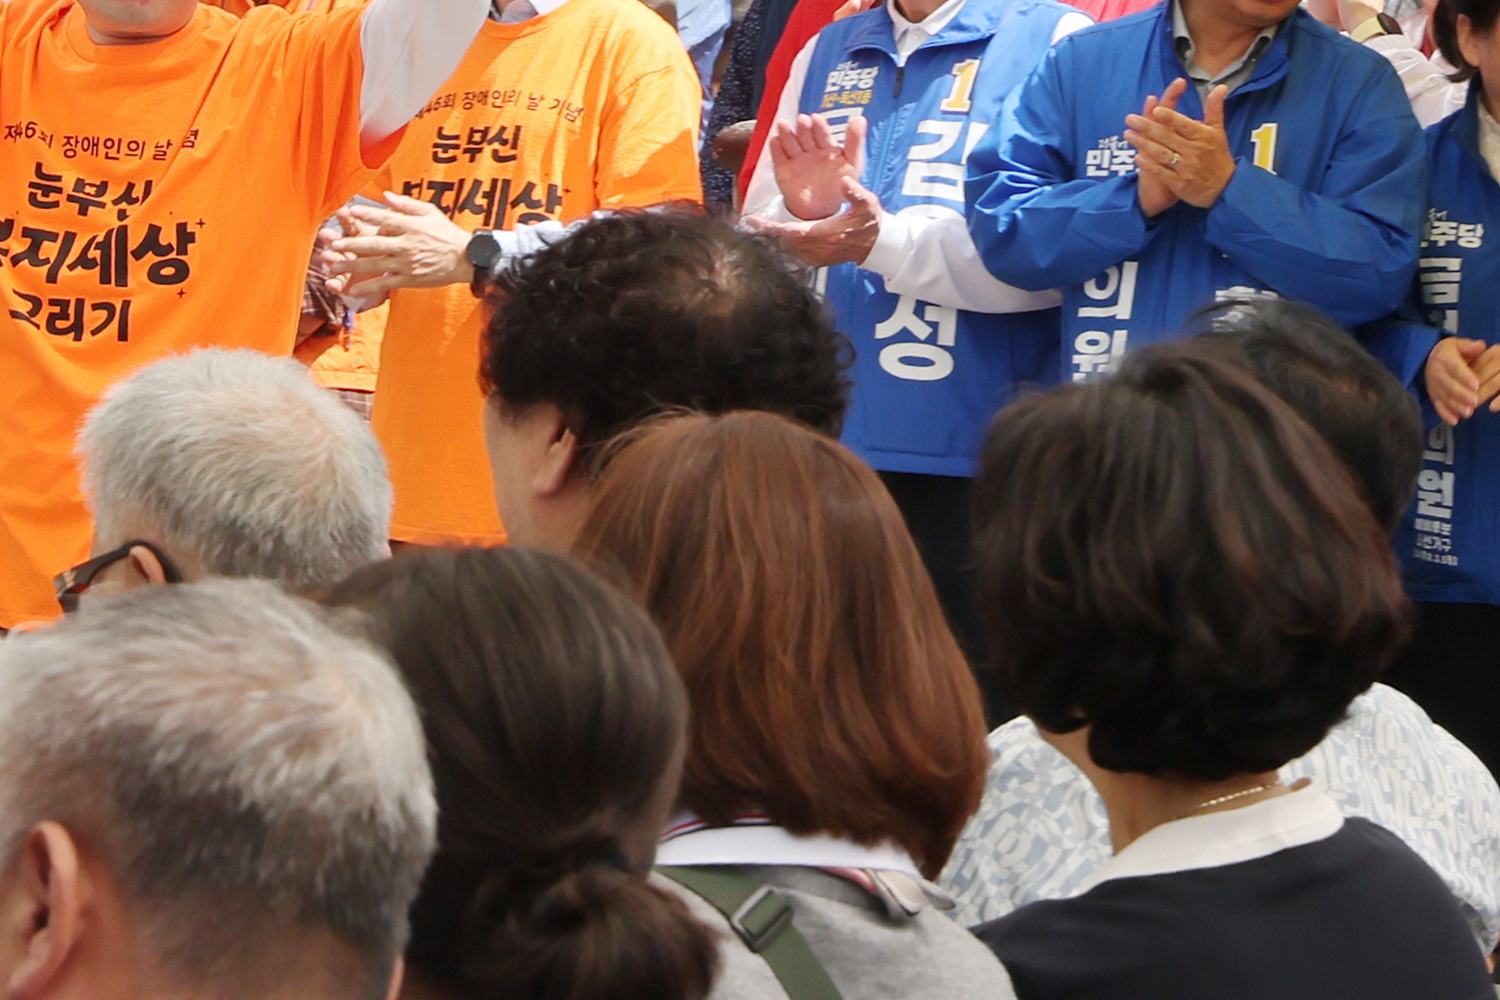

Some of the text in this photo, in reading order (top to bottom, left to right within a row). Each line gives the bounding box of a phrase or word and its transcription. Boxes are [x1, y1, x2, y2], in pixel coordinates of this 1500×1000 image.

[825, 66, 880, 93] 민주당
[940, 58, 981, 114] 1
[526, 91, 545, 111] 날
[62, 134, 146, 161] 장애인의
[152, 138, 173, 161] 날
[432, 125, 522, 164] 눈부신
[1250, 122, 1278, 177] 1
[1086, 149, 1140, 177] 민주
[27, 161, 154, 222] 눈부신
[1420, 221, 1485, 249] 주당
[8, 288, 132, 342] 그리기
